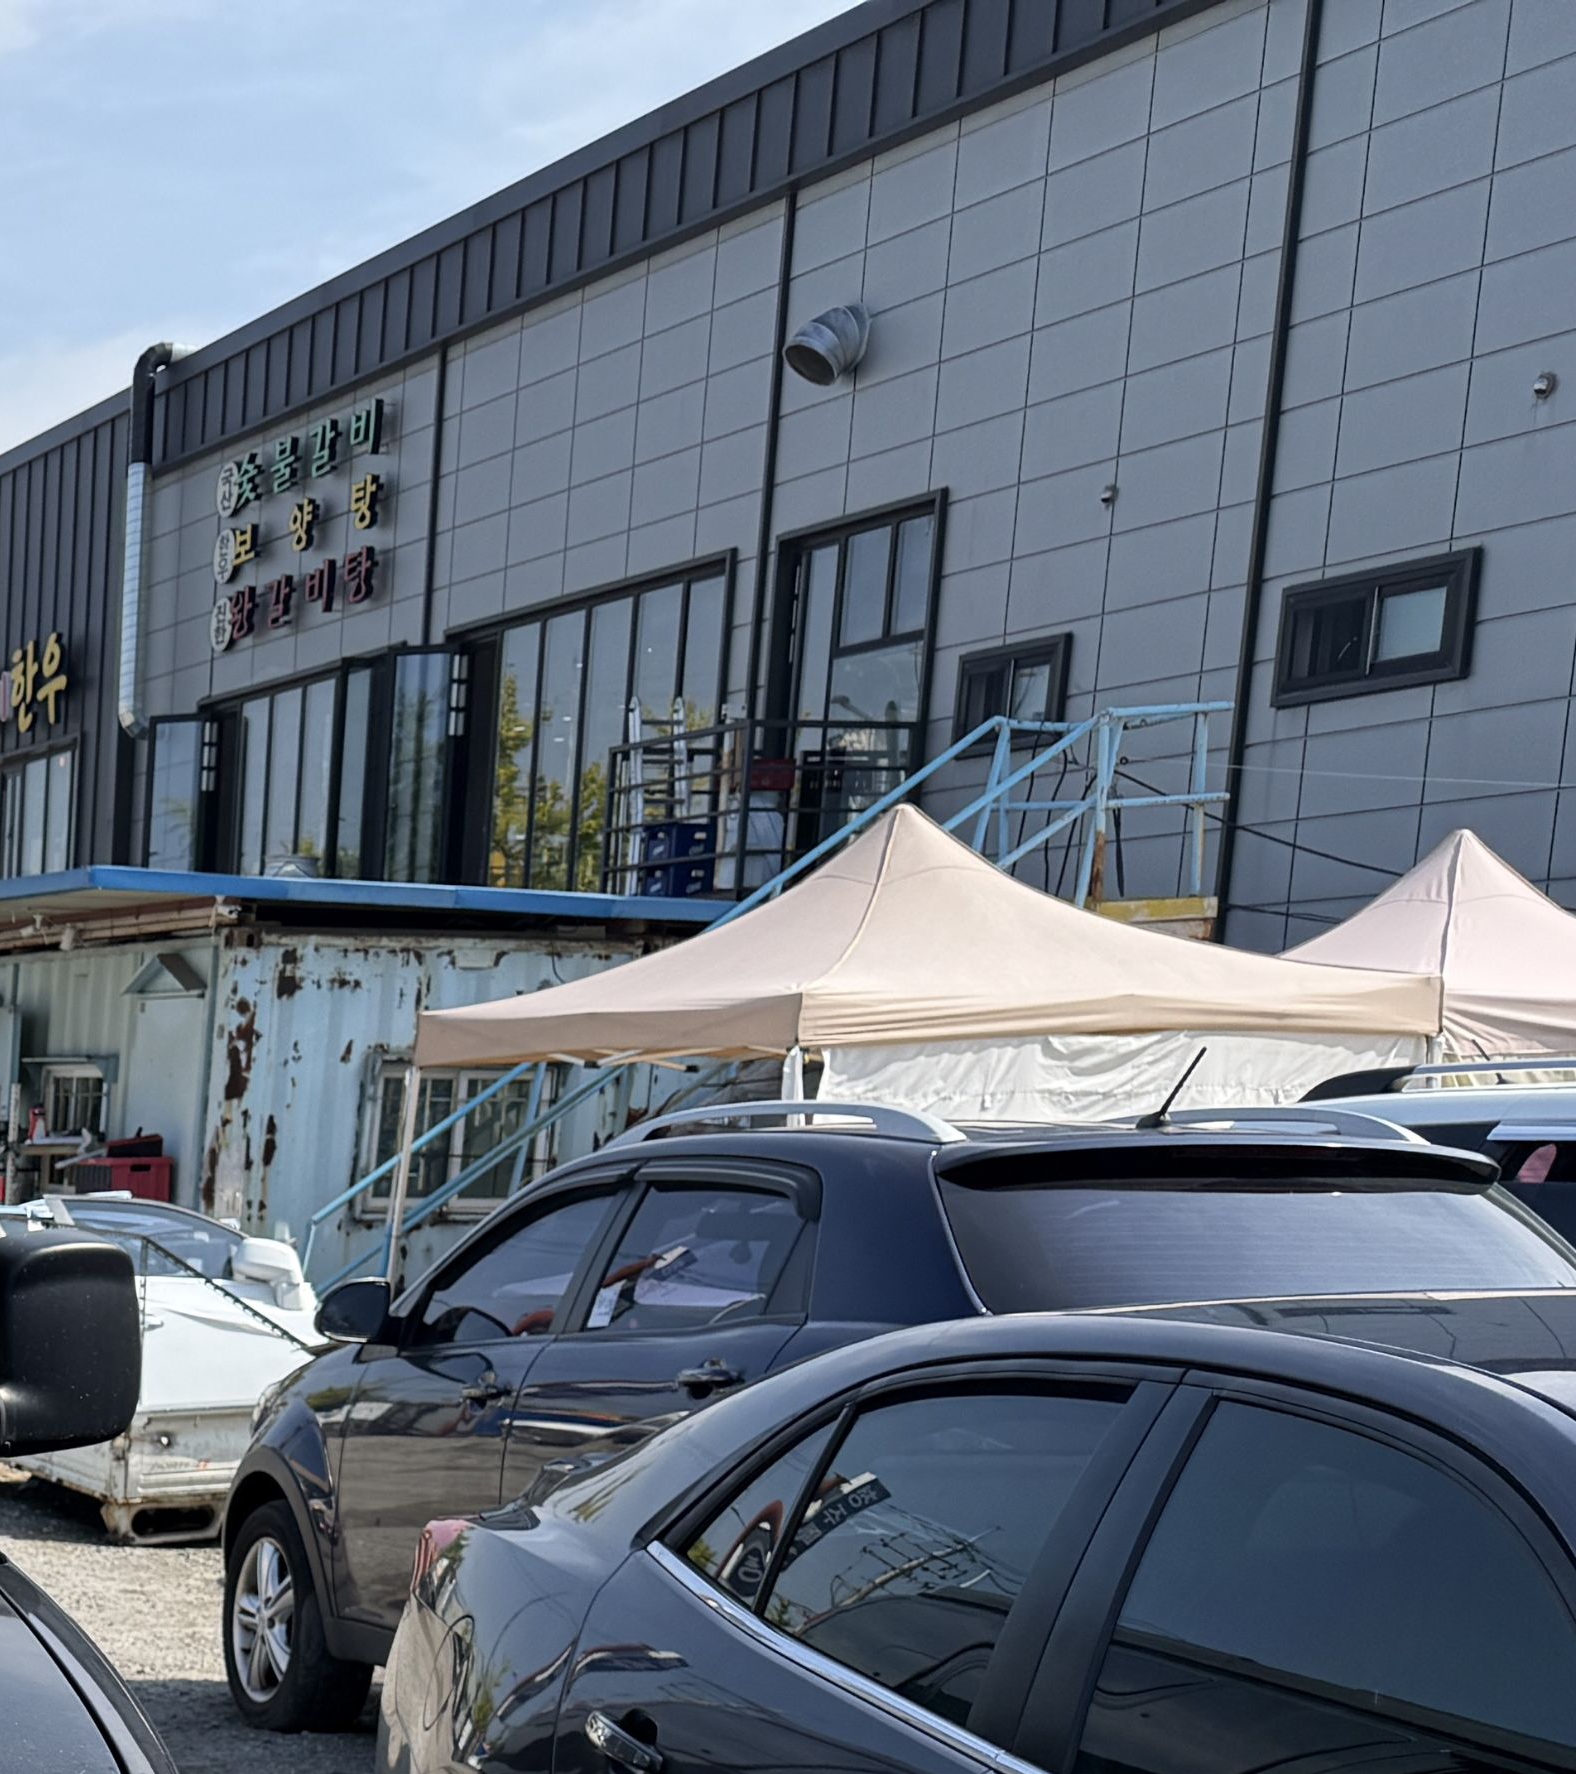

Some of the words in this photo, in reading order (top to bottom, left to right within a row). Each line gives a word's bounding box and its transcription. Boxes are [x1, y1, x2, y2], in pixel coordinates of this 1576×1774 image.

[236, 398, 383, 510] 숯불갈비
[233, 473, 380, 566] 보양탕
[231, 544, 377, 640] 왕갈비탕
[10, 632, 67, 733] 한우
